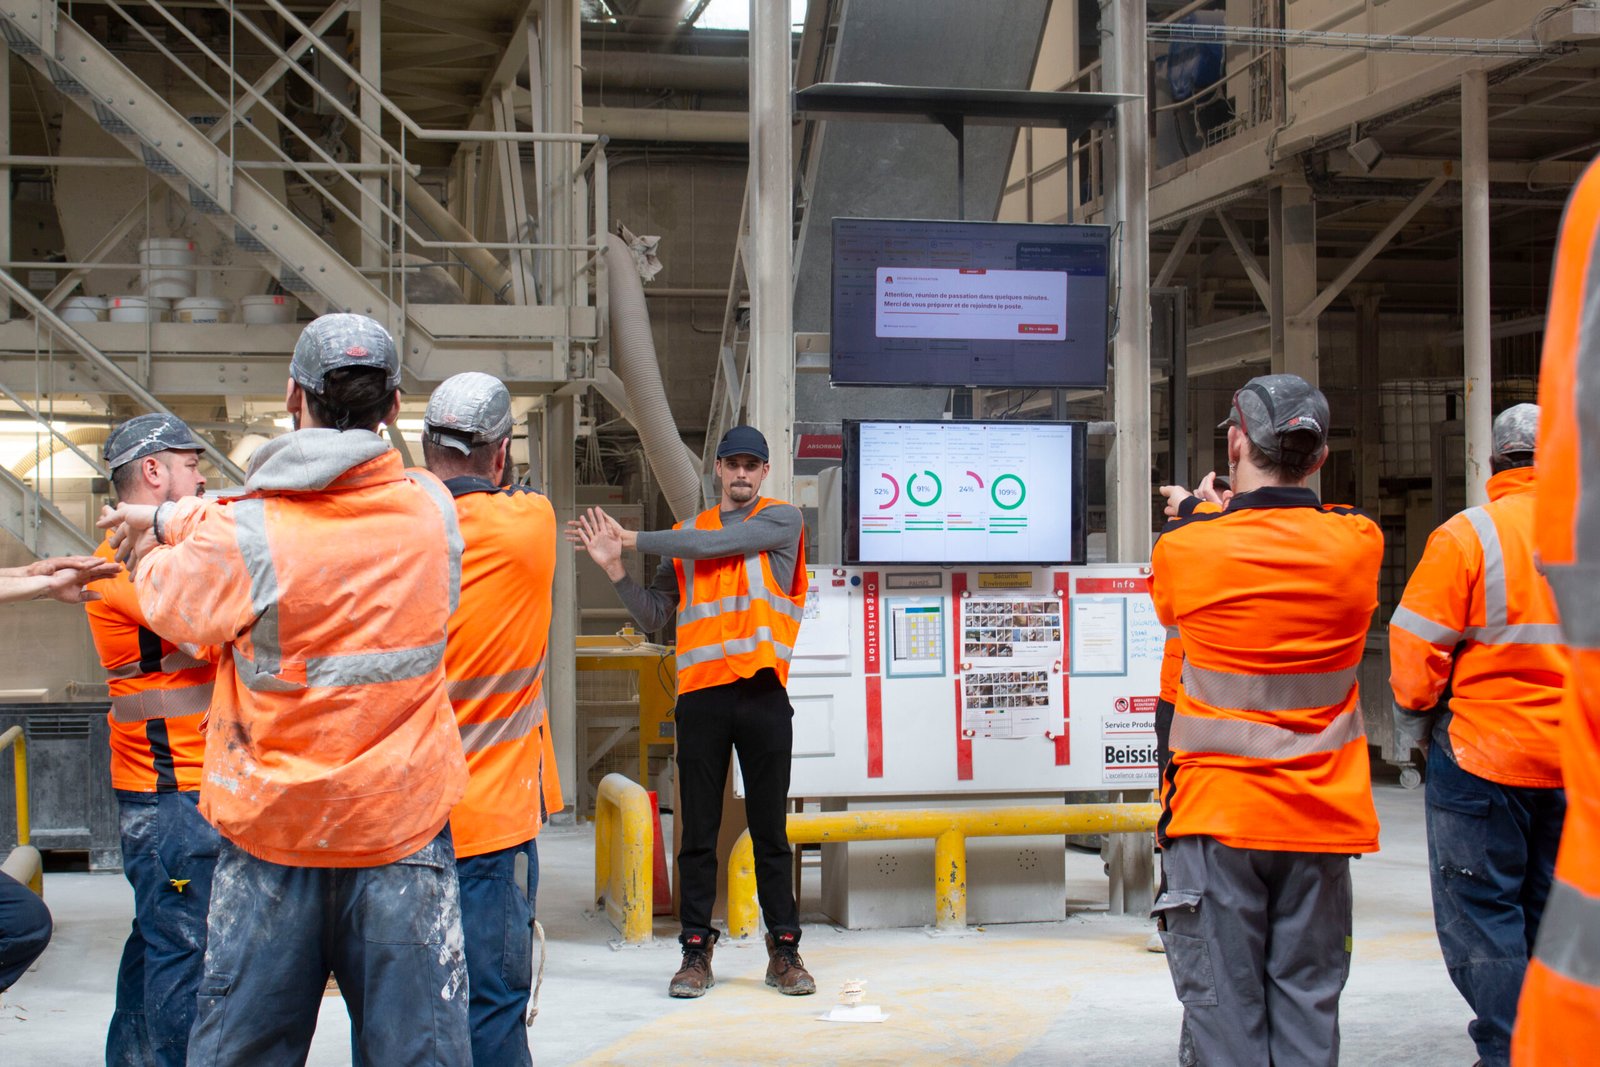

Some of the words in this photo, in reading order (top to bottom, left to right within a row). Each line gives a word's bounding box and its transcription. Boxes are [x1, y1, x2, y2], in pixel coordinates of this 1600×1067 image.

[884, 291, 915, 299] Attention,
[948, 293, 978, 301] passation
[926, 301, 953, 309] préparer
[970, 302, 997, 310] rejoindre
[1112, 580, 1135, 588] Info
[866, 583, 876, 662] Organisation
[1105, 721, 1130, 729] Service
